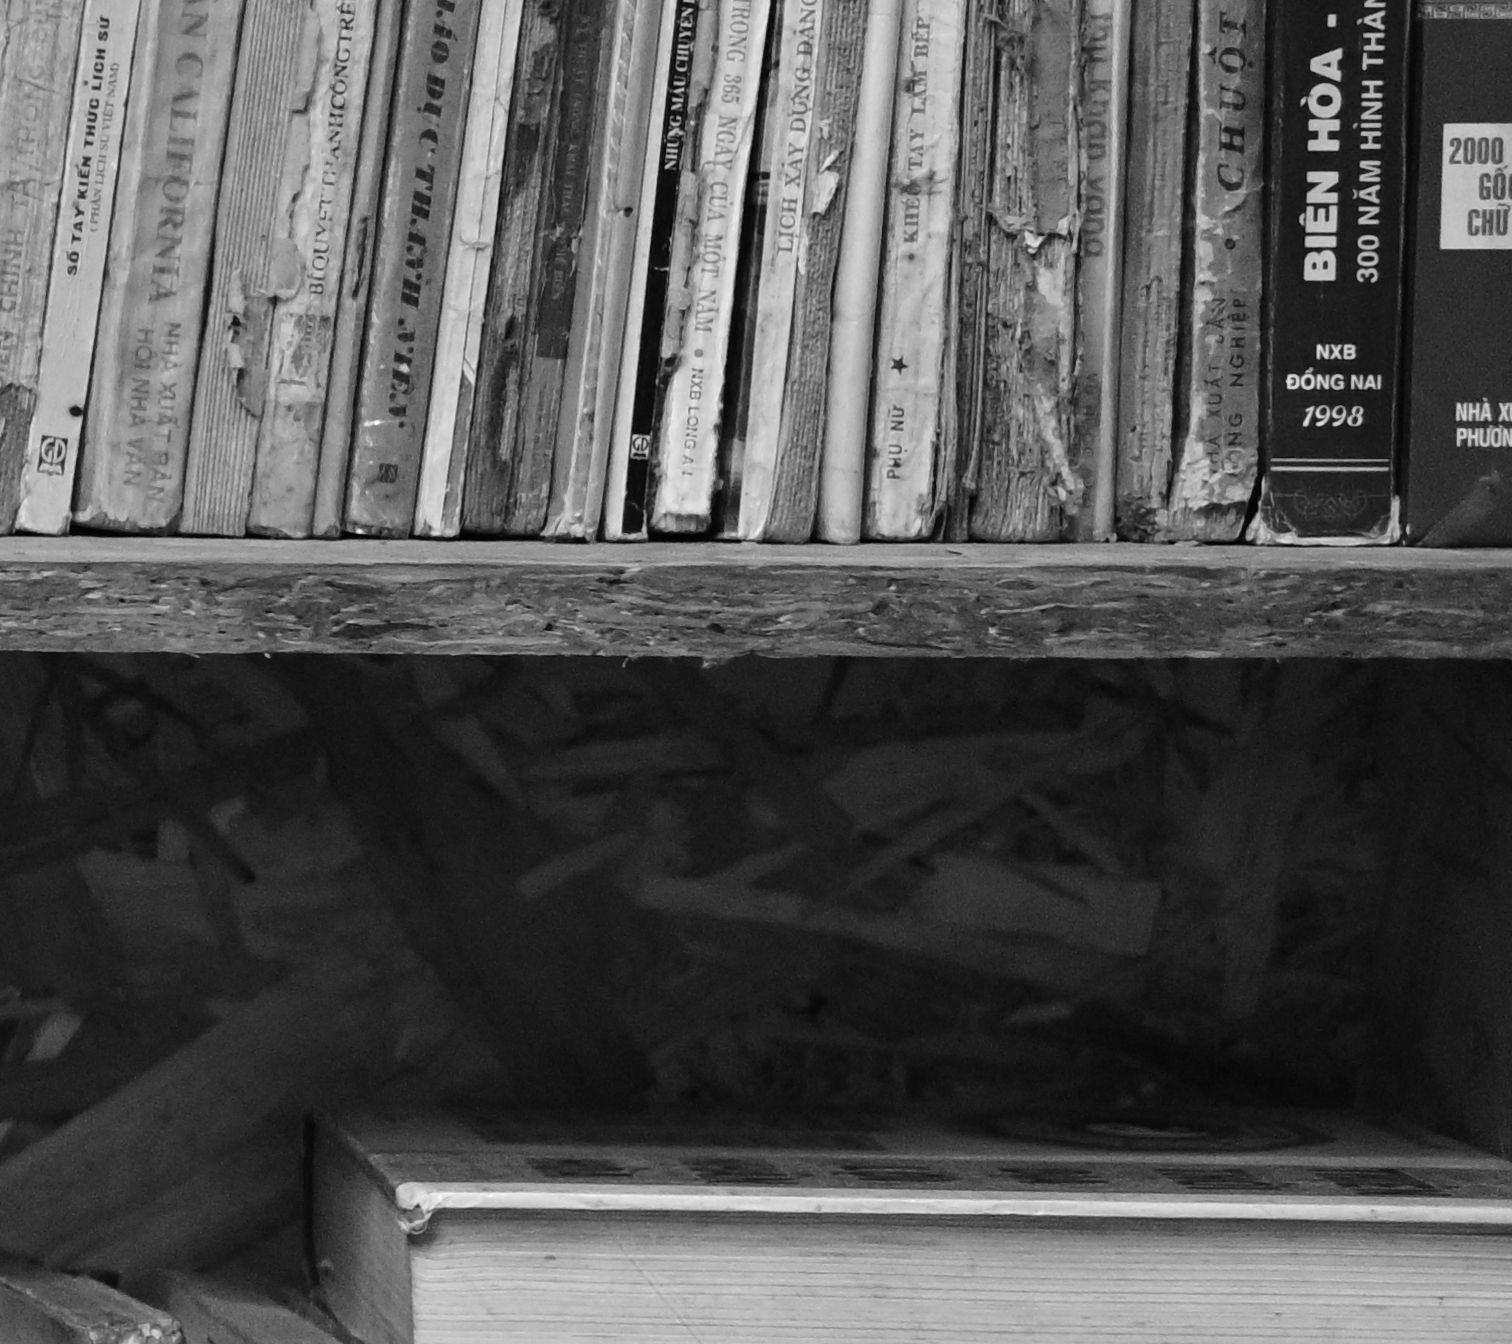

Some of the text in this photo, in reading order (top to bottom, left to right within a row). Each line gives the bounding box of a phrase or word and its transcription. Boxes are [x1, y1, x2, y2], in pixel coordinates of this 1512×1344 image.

[1300, 48, 1343, 151] HÒA
[1448, 137, 1504, 165] 2000
[1299, 171, 1339, 281] BIÊN
[1467, 202, 1511, 236] CHỮ
[1316, 344, 1357, 360] NXB
[1286, 367, 1382, 390] ĐỒNG NAI
[1302, 405, 1365, 428] 1998
